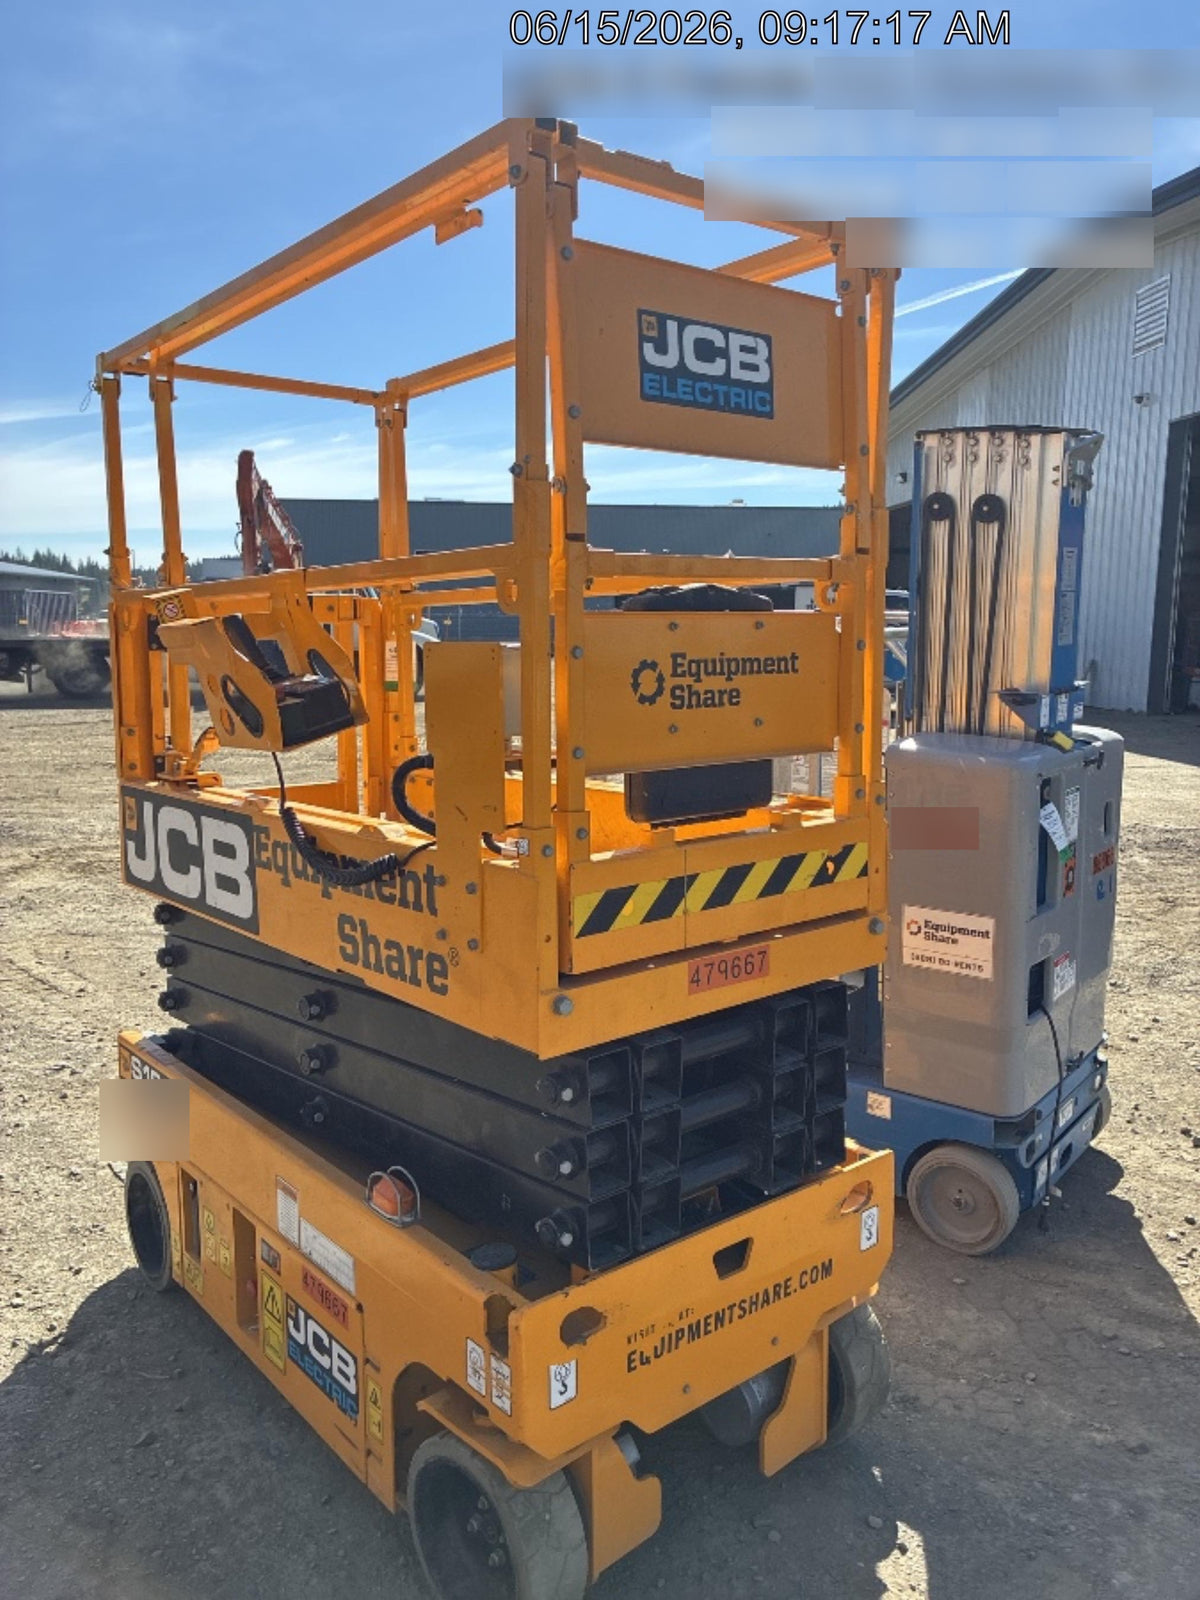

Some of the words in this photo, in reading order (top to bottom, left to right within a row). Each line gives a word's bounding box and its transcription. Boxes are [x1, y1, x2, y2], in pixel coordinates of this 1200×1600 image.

[643, 319, 771, 384] JCB
[643, 372, 771, 413] ELECTRIC
[670, 652, 799, 683] Equipment
[670, 683, 741, 710] Share
[127, 801, 253, 919] JCB
[924, 919, 991, 940] Equipment
[924, 930, 959, 945] Share
[690, 950, 767, 987] 479667
[302, 1270, 348, 1323] 479667
[288, 1308, 356, 1395] JCB
[288, 1339, 358, 1419] ELECTRIC
